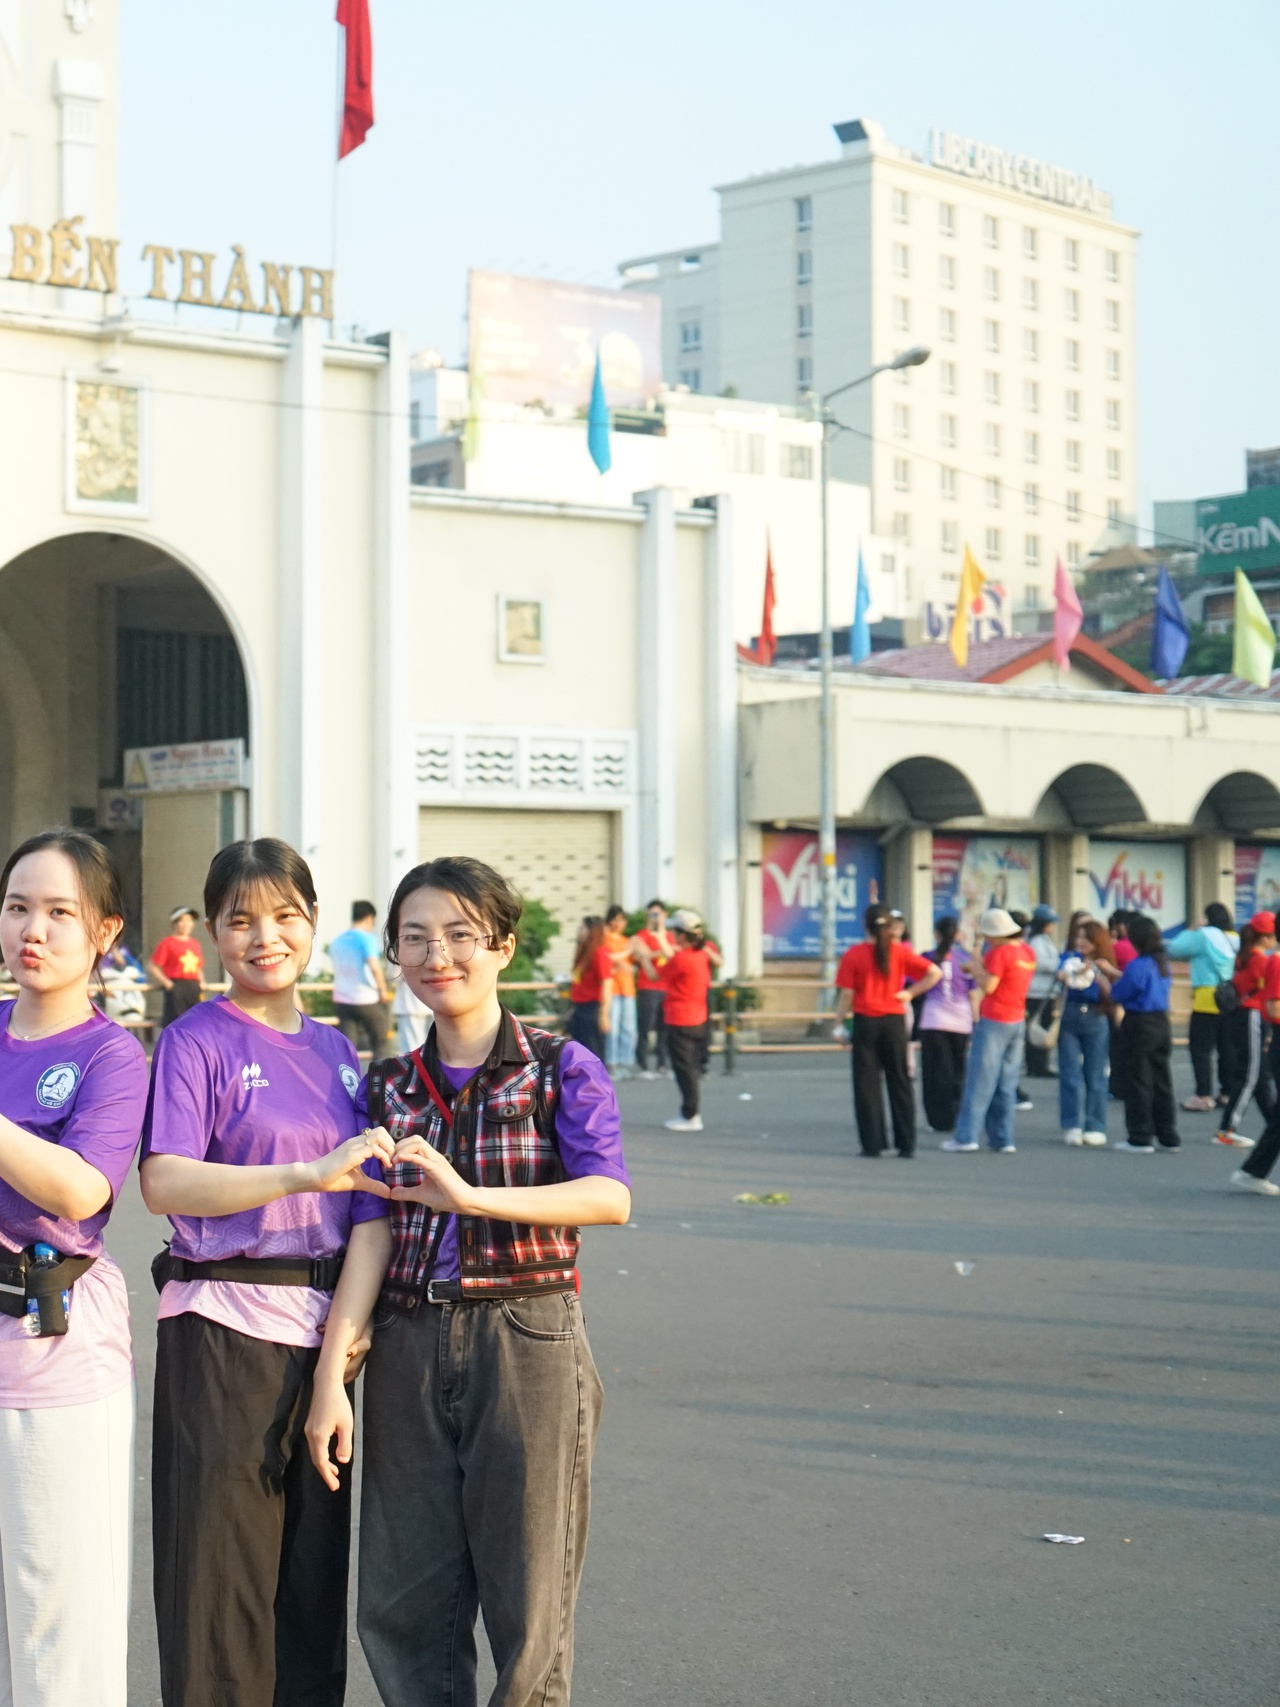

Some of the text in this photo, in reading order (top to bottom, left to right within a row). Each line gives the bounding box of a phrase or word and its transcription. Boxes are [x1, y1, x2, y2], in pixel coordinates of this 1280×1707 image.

[10, 214, 120, 294] BẾN
[141, 243, 335, 321] THÀNH
[1088, 850, 1163, 910] Vikki
